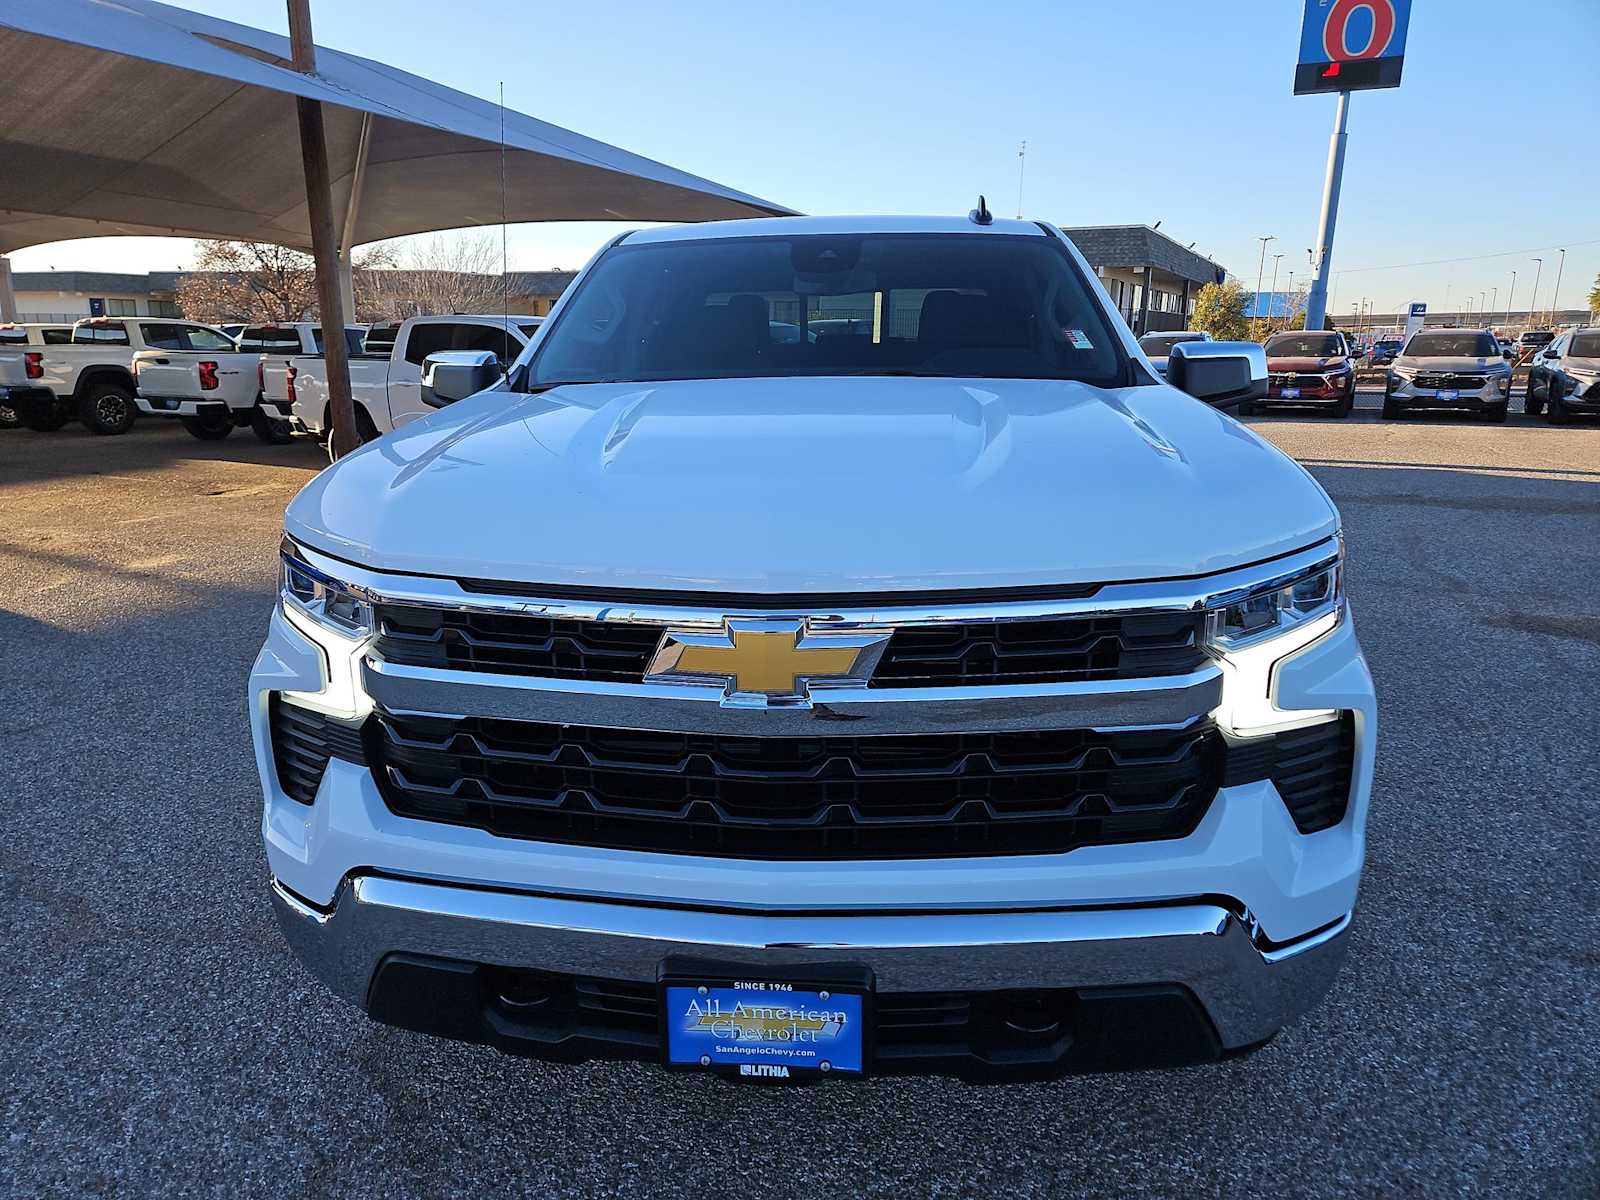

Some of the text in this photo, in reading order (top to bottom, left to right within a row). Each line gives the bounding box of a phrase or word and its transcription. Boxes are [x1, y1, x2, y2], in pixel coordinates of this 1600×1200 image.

[734, 982, 793, 992] SINCE 1946
[685, 999, 848, 1023] All American
[711, 1020, 818, 1042] Chevrolet
[715, 1045, 816, 1057] SanAngeloChevy.com
[752, 1065, 790, 1077] LITHIA
